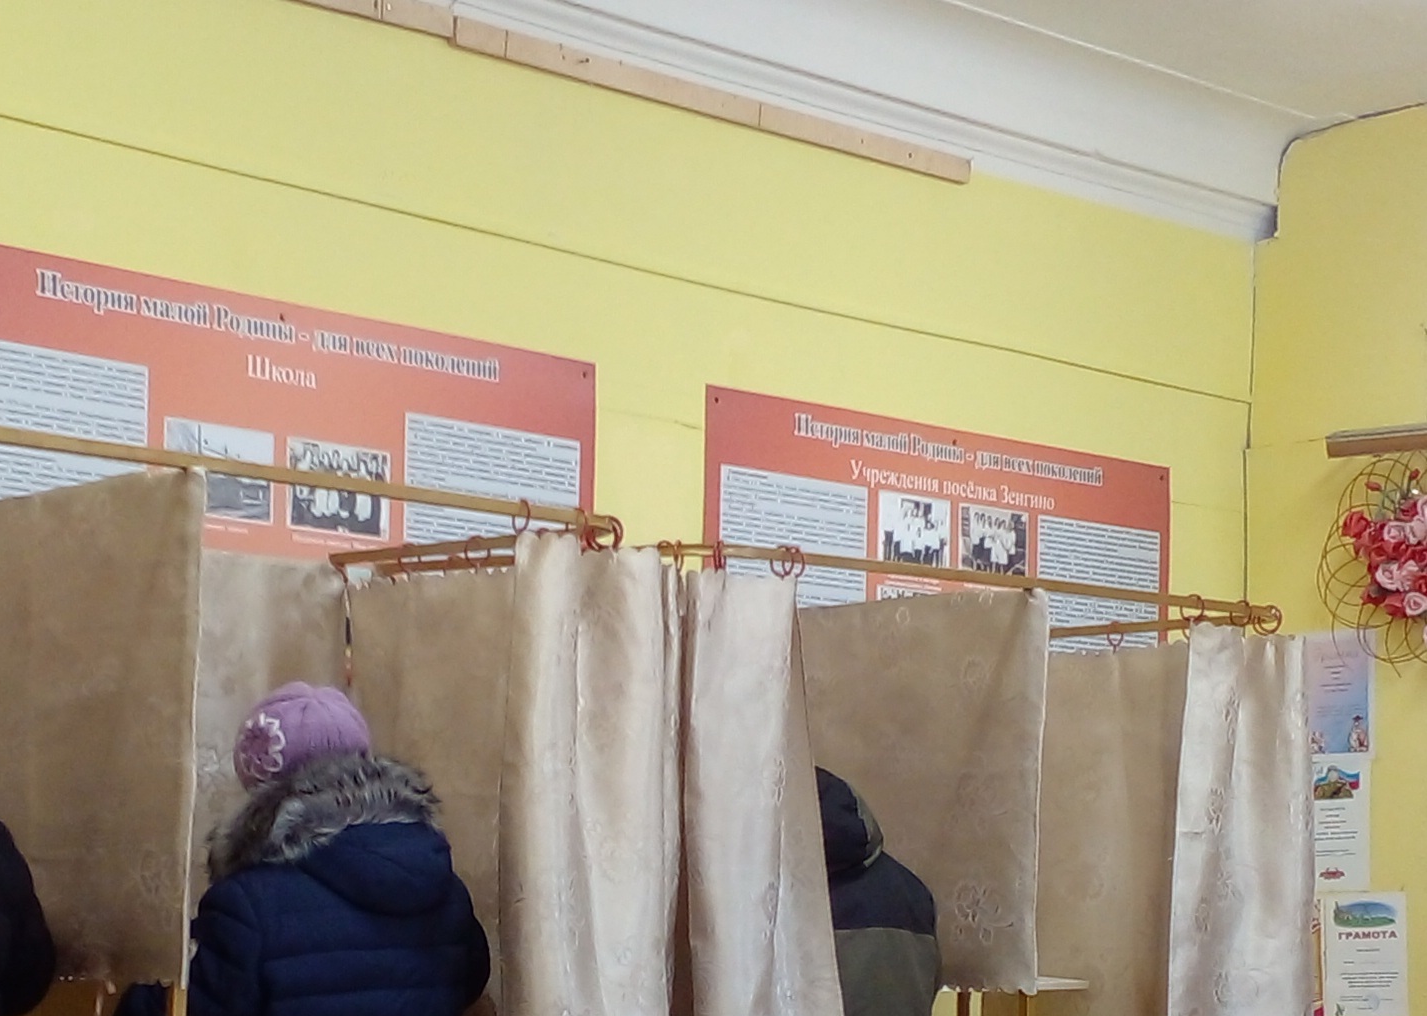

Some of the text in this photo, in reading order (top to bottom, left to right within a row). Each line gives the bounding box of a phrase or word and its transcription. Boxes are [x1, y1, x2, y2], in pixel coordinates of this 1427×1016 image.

[36, 268, 137, 314] История
[141, 296, 210, 327] малой
[212, 304, 295, 344] Родины
[313, 330, 350, 354] для
[353, 337, 400, 362] всех
[400, 347, 500, 383] поколений
[246, 354, 316, 389] Школа
[794, 413, 861, 448] История
[863, 430, 908, 454] малой
[910, 434, 965, 464] Родины
[1003, 455, 1032, 475] всех
[1034, 460, 1103, 487] поколений
[850, 459, 1055, 510] Учреждения посёлка Зенгино
[1338, 930, 1398, 940] ГРАМОТА
